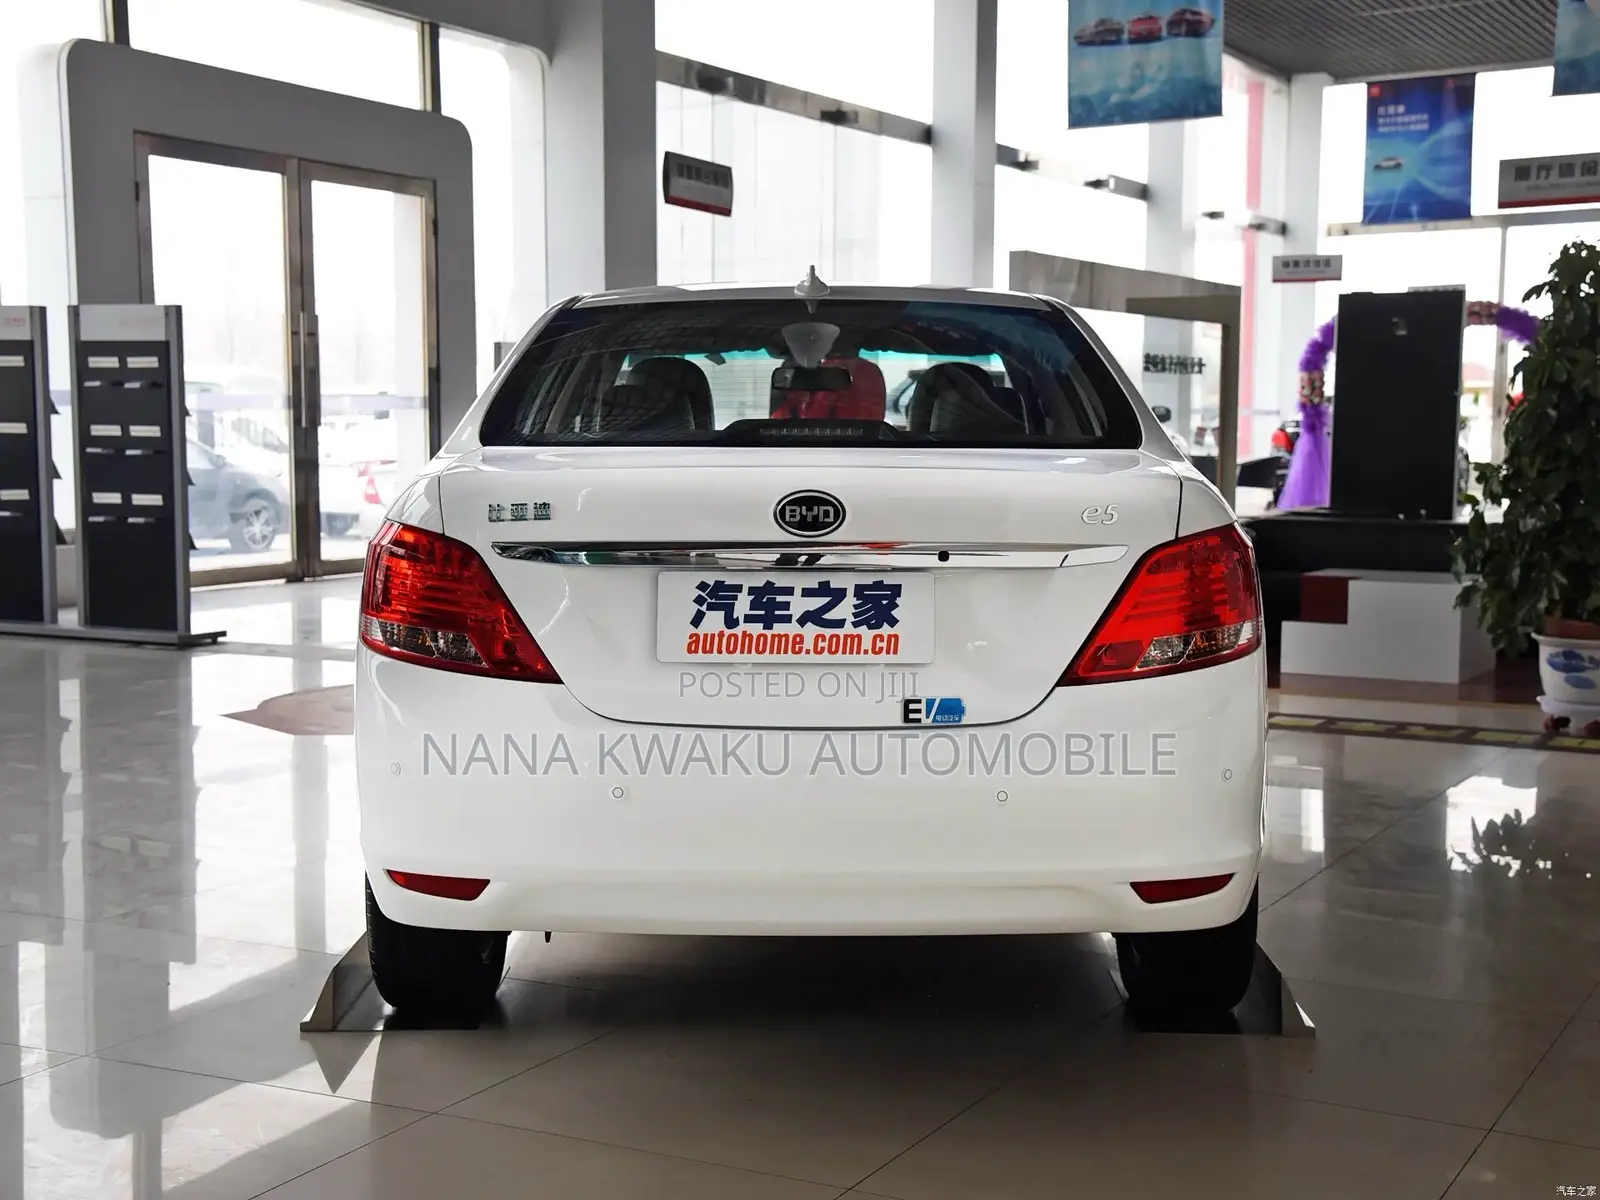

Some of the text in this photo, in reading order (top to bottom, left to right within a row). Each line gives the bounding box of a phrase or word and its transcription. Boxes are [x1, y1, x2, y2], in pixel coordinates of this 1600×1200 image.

[487, 502, 551, 522] 比亚迪
[785, 505, 834, 522] BYD
[1081, 504, 1119, 525] e5
[689, 580, 902, 630] 汽车之家
[686, 630, 900, 655] autohome.com.cn
